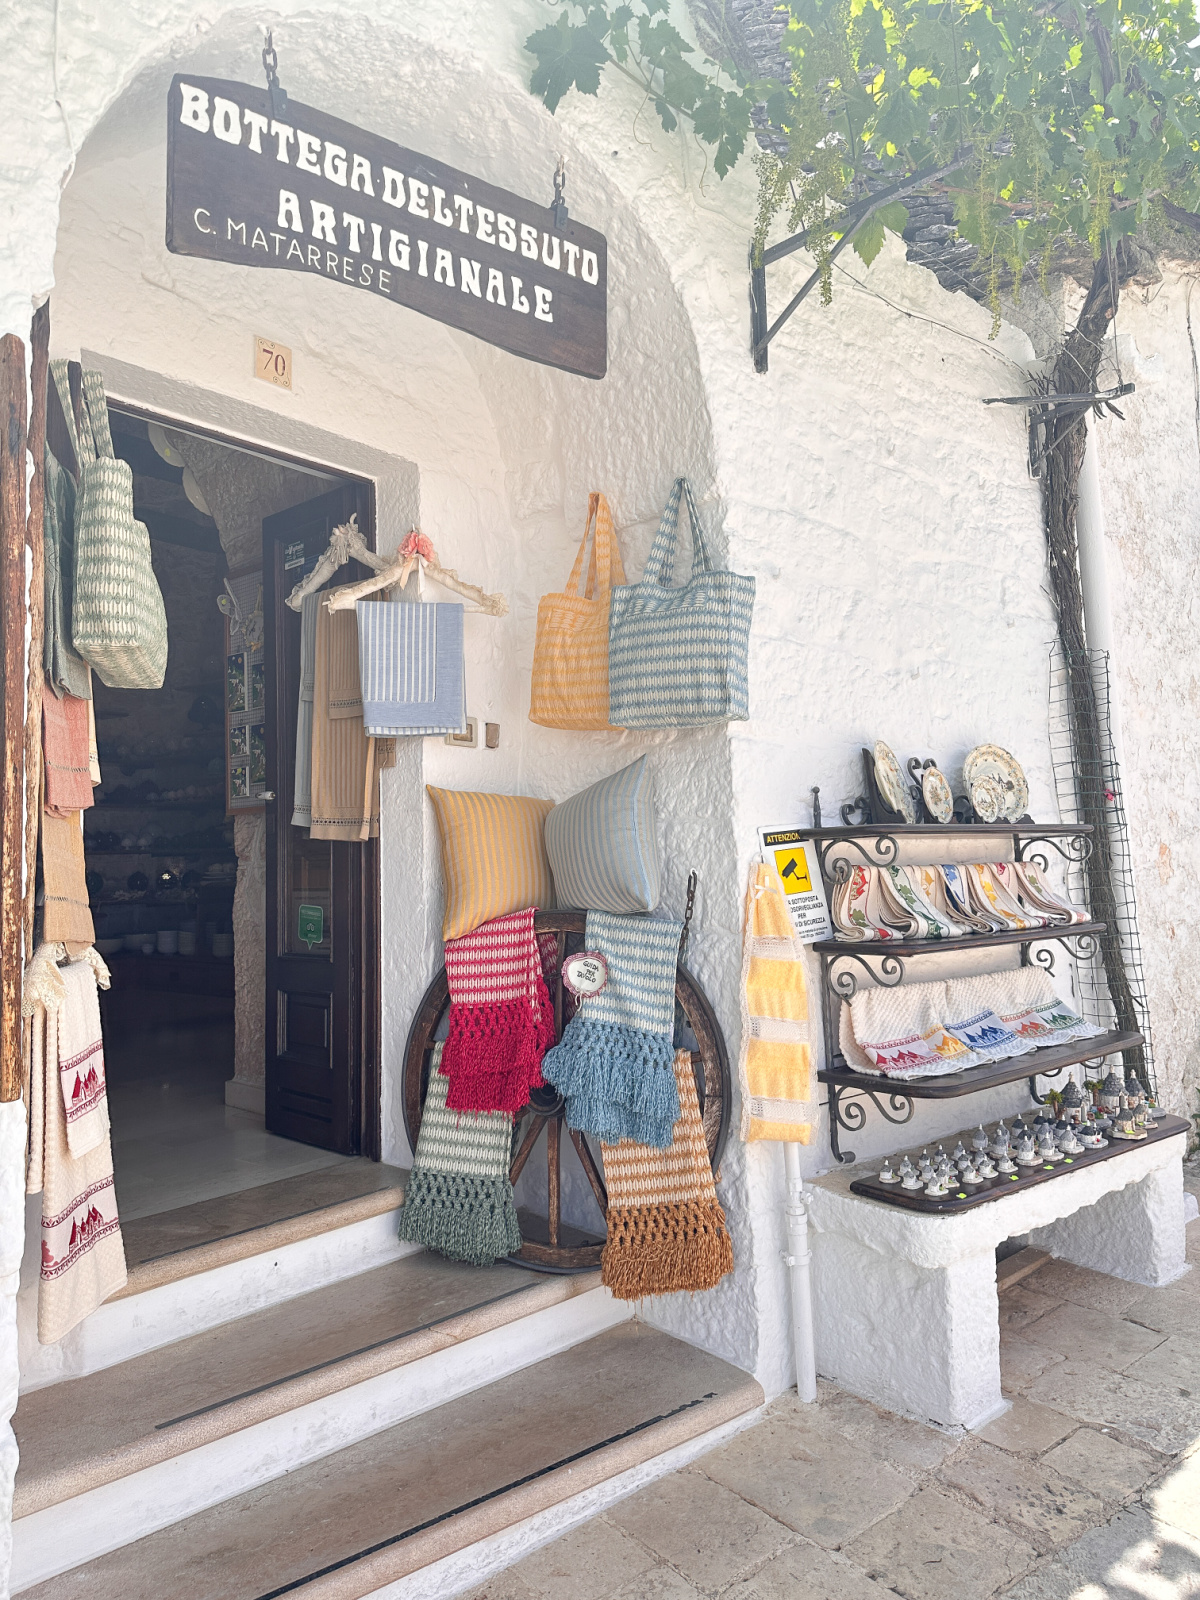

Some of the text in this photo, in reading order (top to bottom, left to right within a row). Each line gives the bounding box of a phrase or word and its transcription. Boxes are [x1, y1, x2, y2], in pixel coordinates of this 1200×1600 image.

[180, 82, 599, 286] BOTTEGA DEL TESSUTO
[193, 207, 392, 294] C. MATARRESE
[277, 188, 554, 323] ARTIGIANALE
[262, 348, 286, 377] 70
[766, 832, 800, 844] ATTENZION
